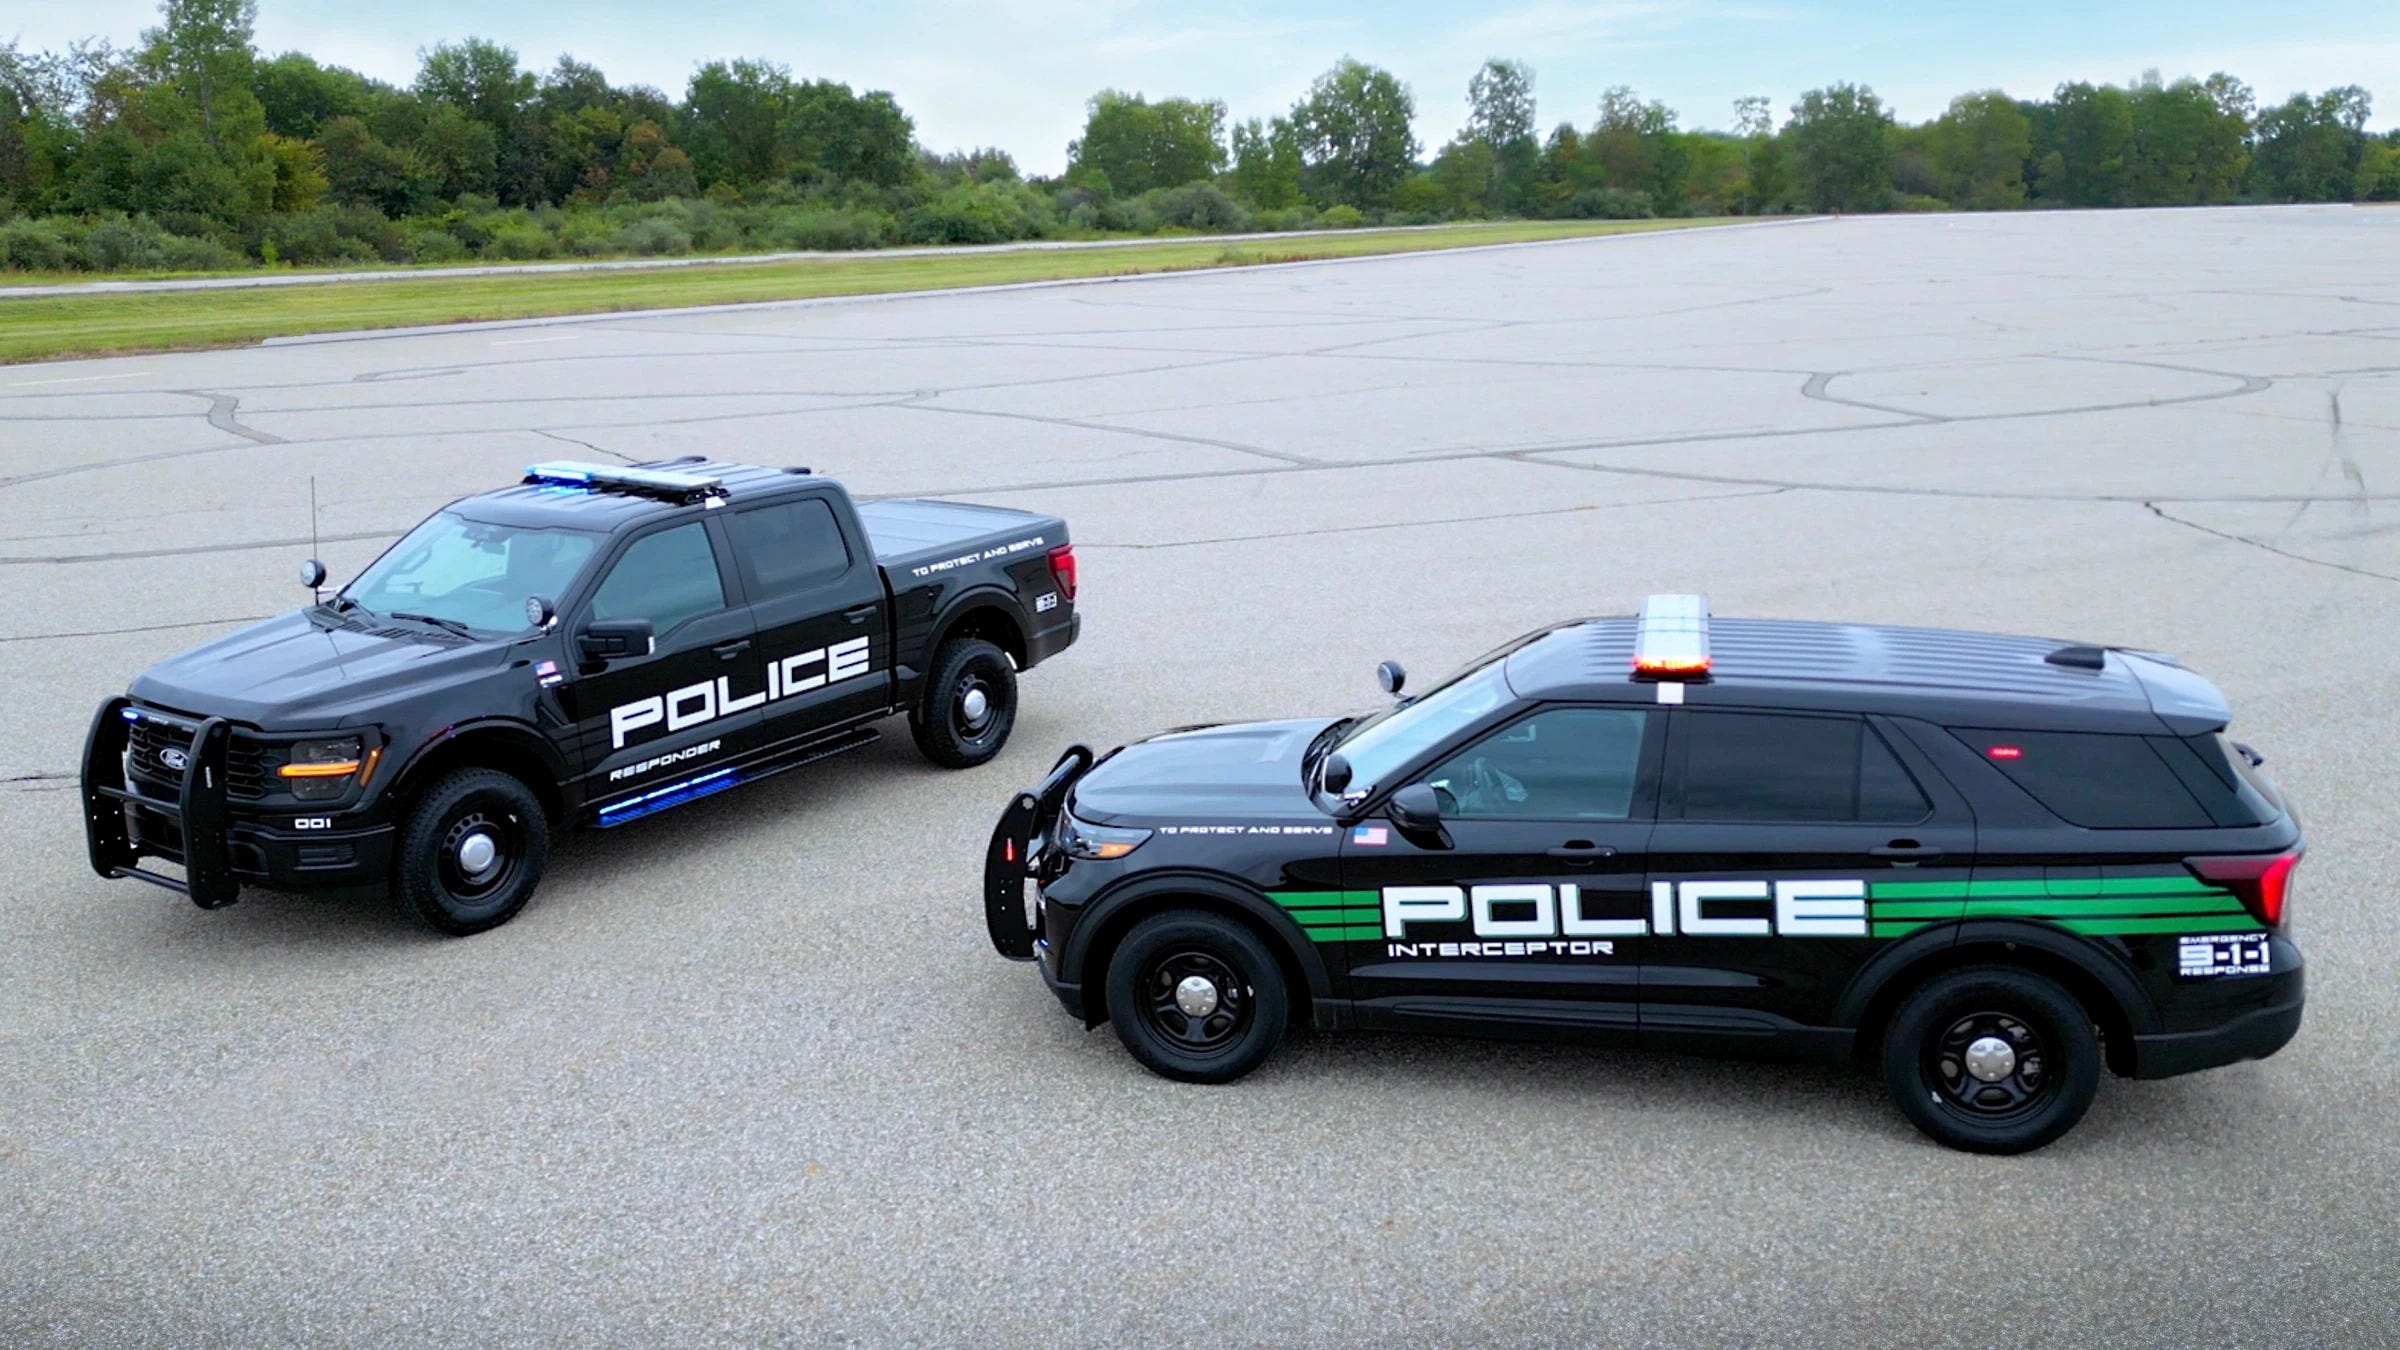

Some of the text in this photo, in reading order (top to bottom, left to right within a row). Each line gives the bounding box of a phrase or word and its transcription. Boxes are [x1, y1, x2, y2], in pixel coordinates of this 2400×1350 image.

[912, 536, 1044, 577] TO PROTECT AND SERVE
[611, 635, 869, 749] POLICE
[610, 740, 721, 782] RESPONDER
[1159, 826, 1333, 834] TO PROTECT AND SERVE
[1382, 880, 1867, 937] POLICE
[1388, 941, 1613, 958] INTERCEPTOR
[2179, 933, 2267, 944] EMERGENCY
[2180, 964, 2270, 976] RESPONSE
